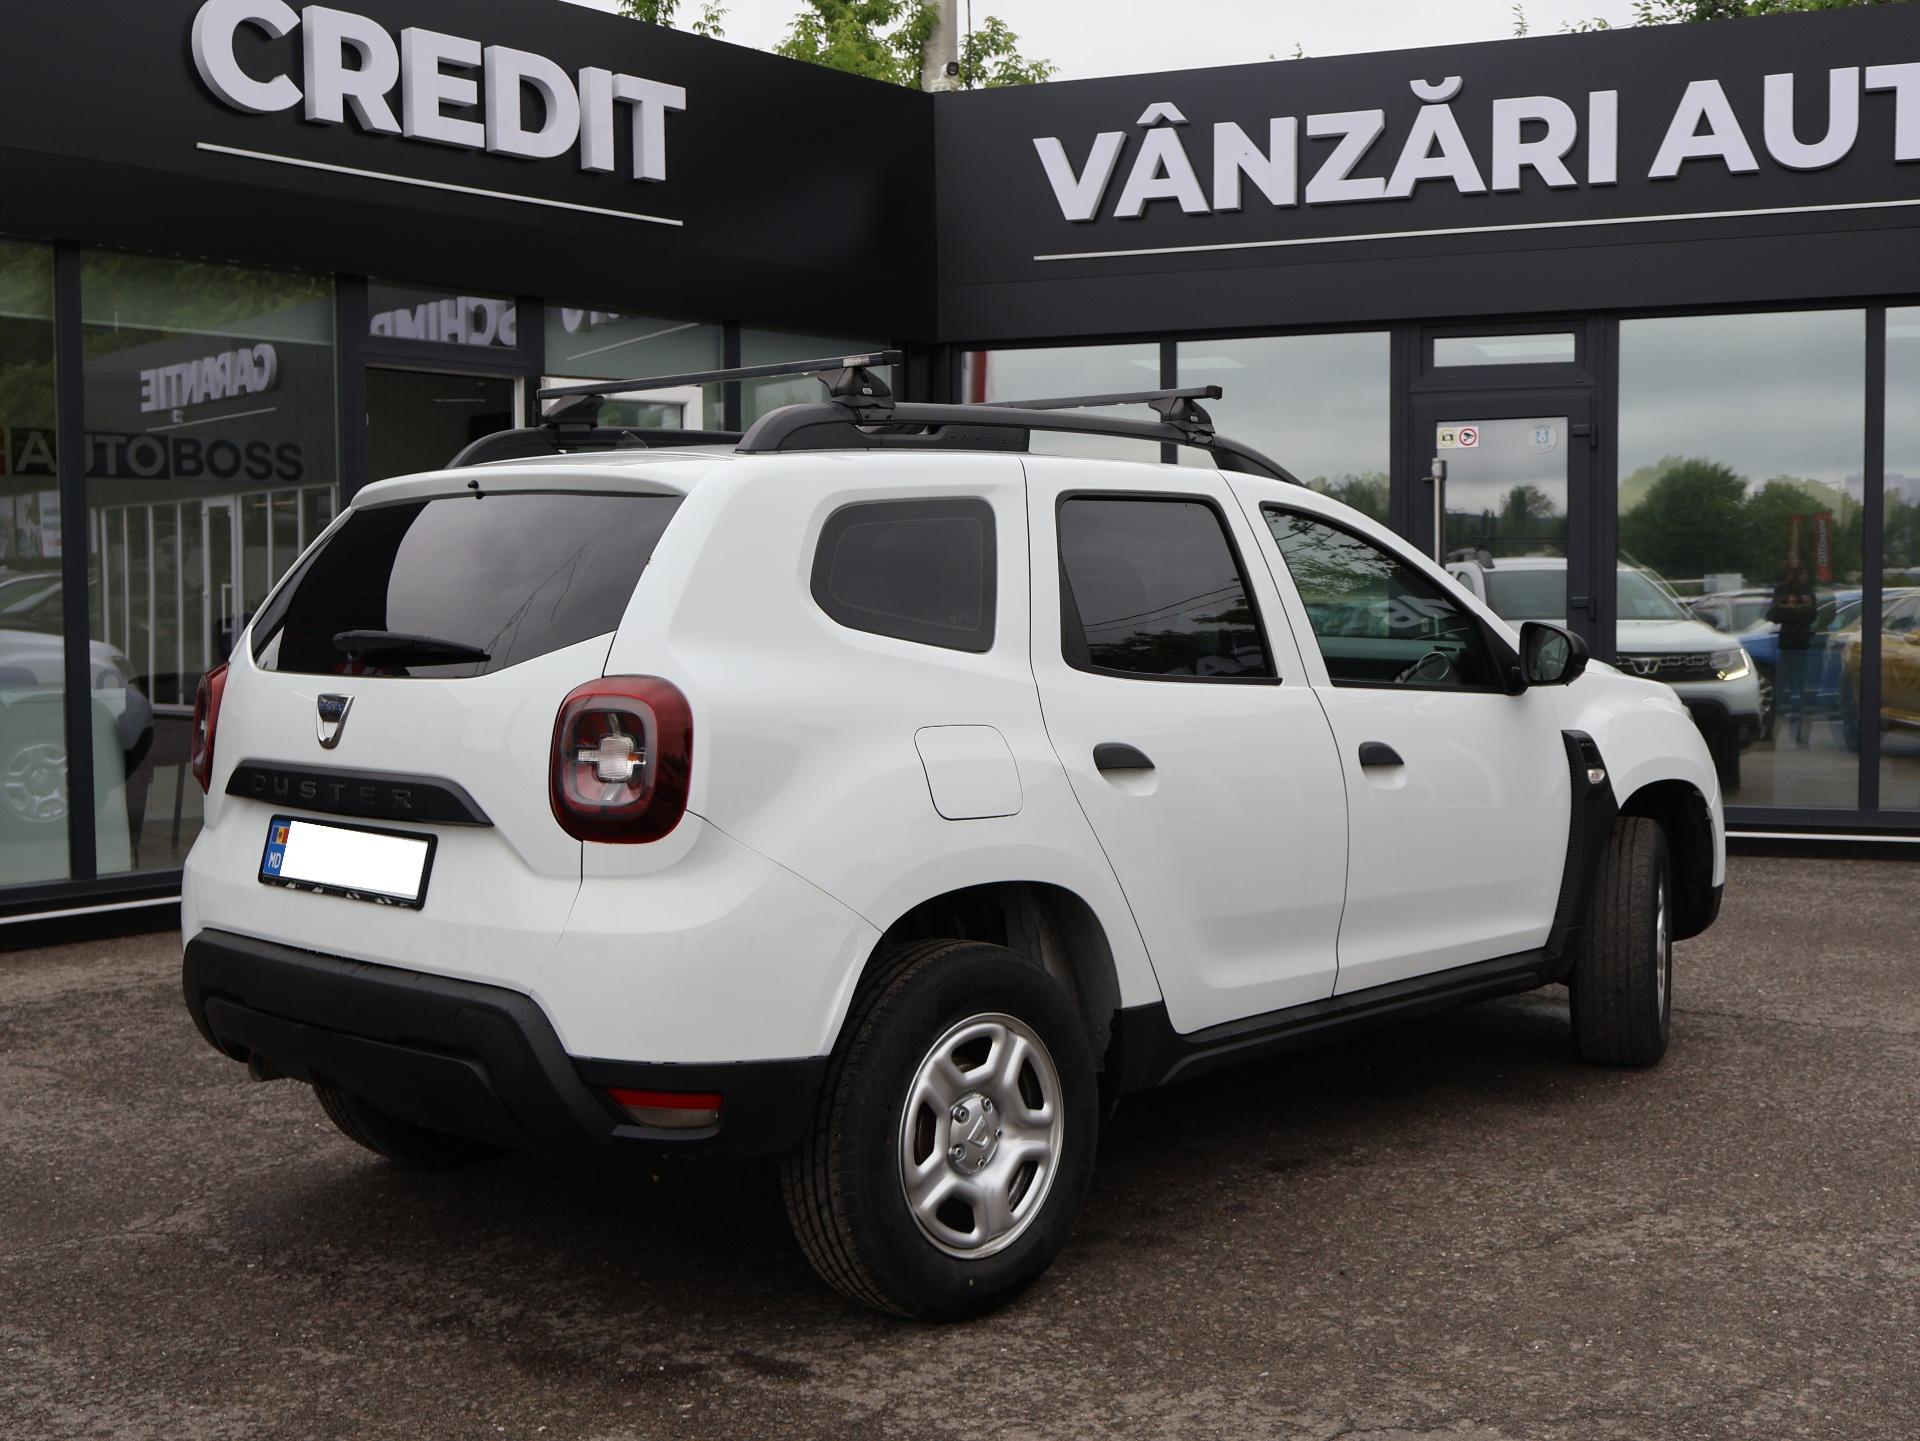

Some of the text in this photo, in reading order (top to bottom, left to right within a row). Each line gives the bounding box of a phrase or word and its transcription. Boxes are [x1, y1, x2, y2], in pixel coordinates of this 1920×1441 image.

[191, 0, 687, 182] CREDIT
[1032, 75, 1618, 222] VÂNZĂRI
[253, 774, 412, 809] DUSTER
[268, 852, 282, 869] MD
